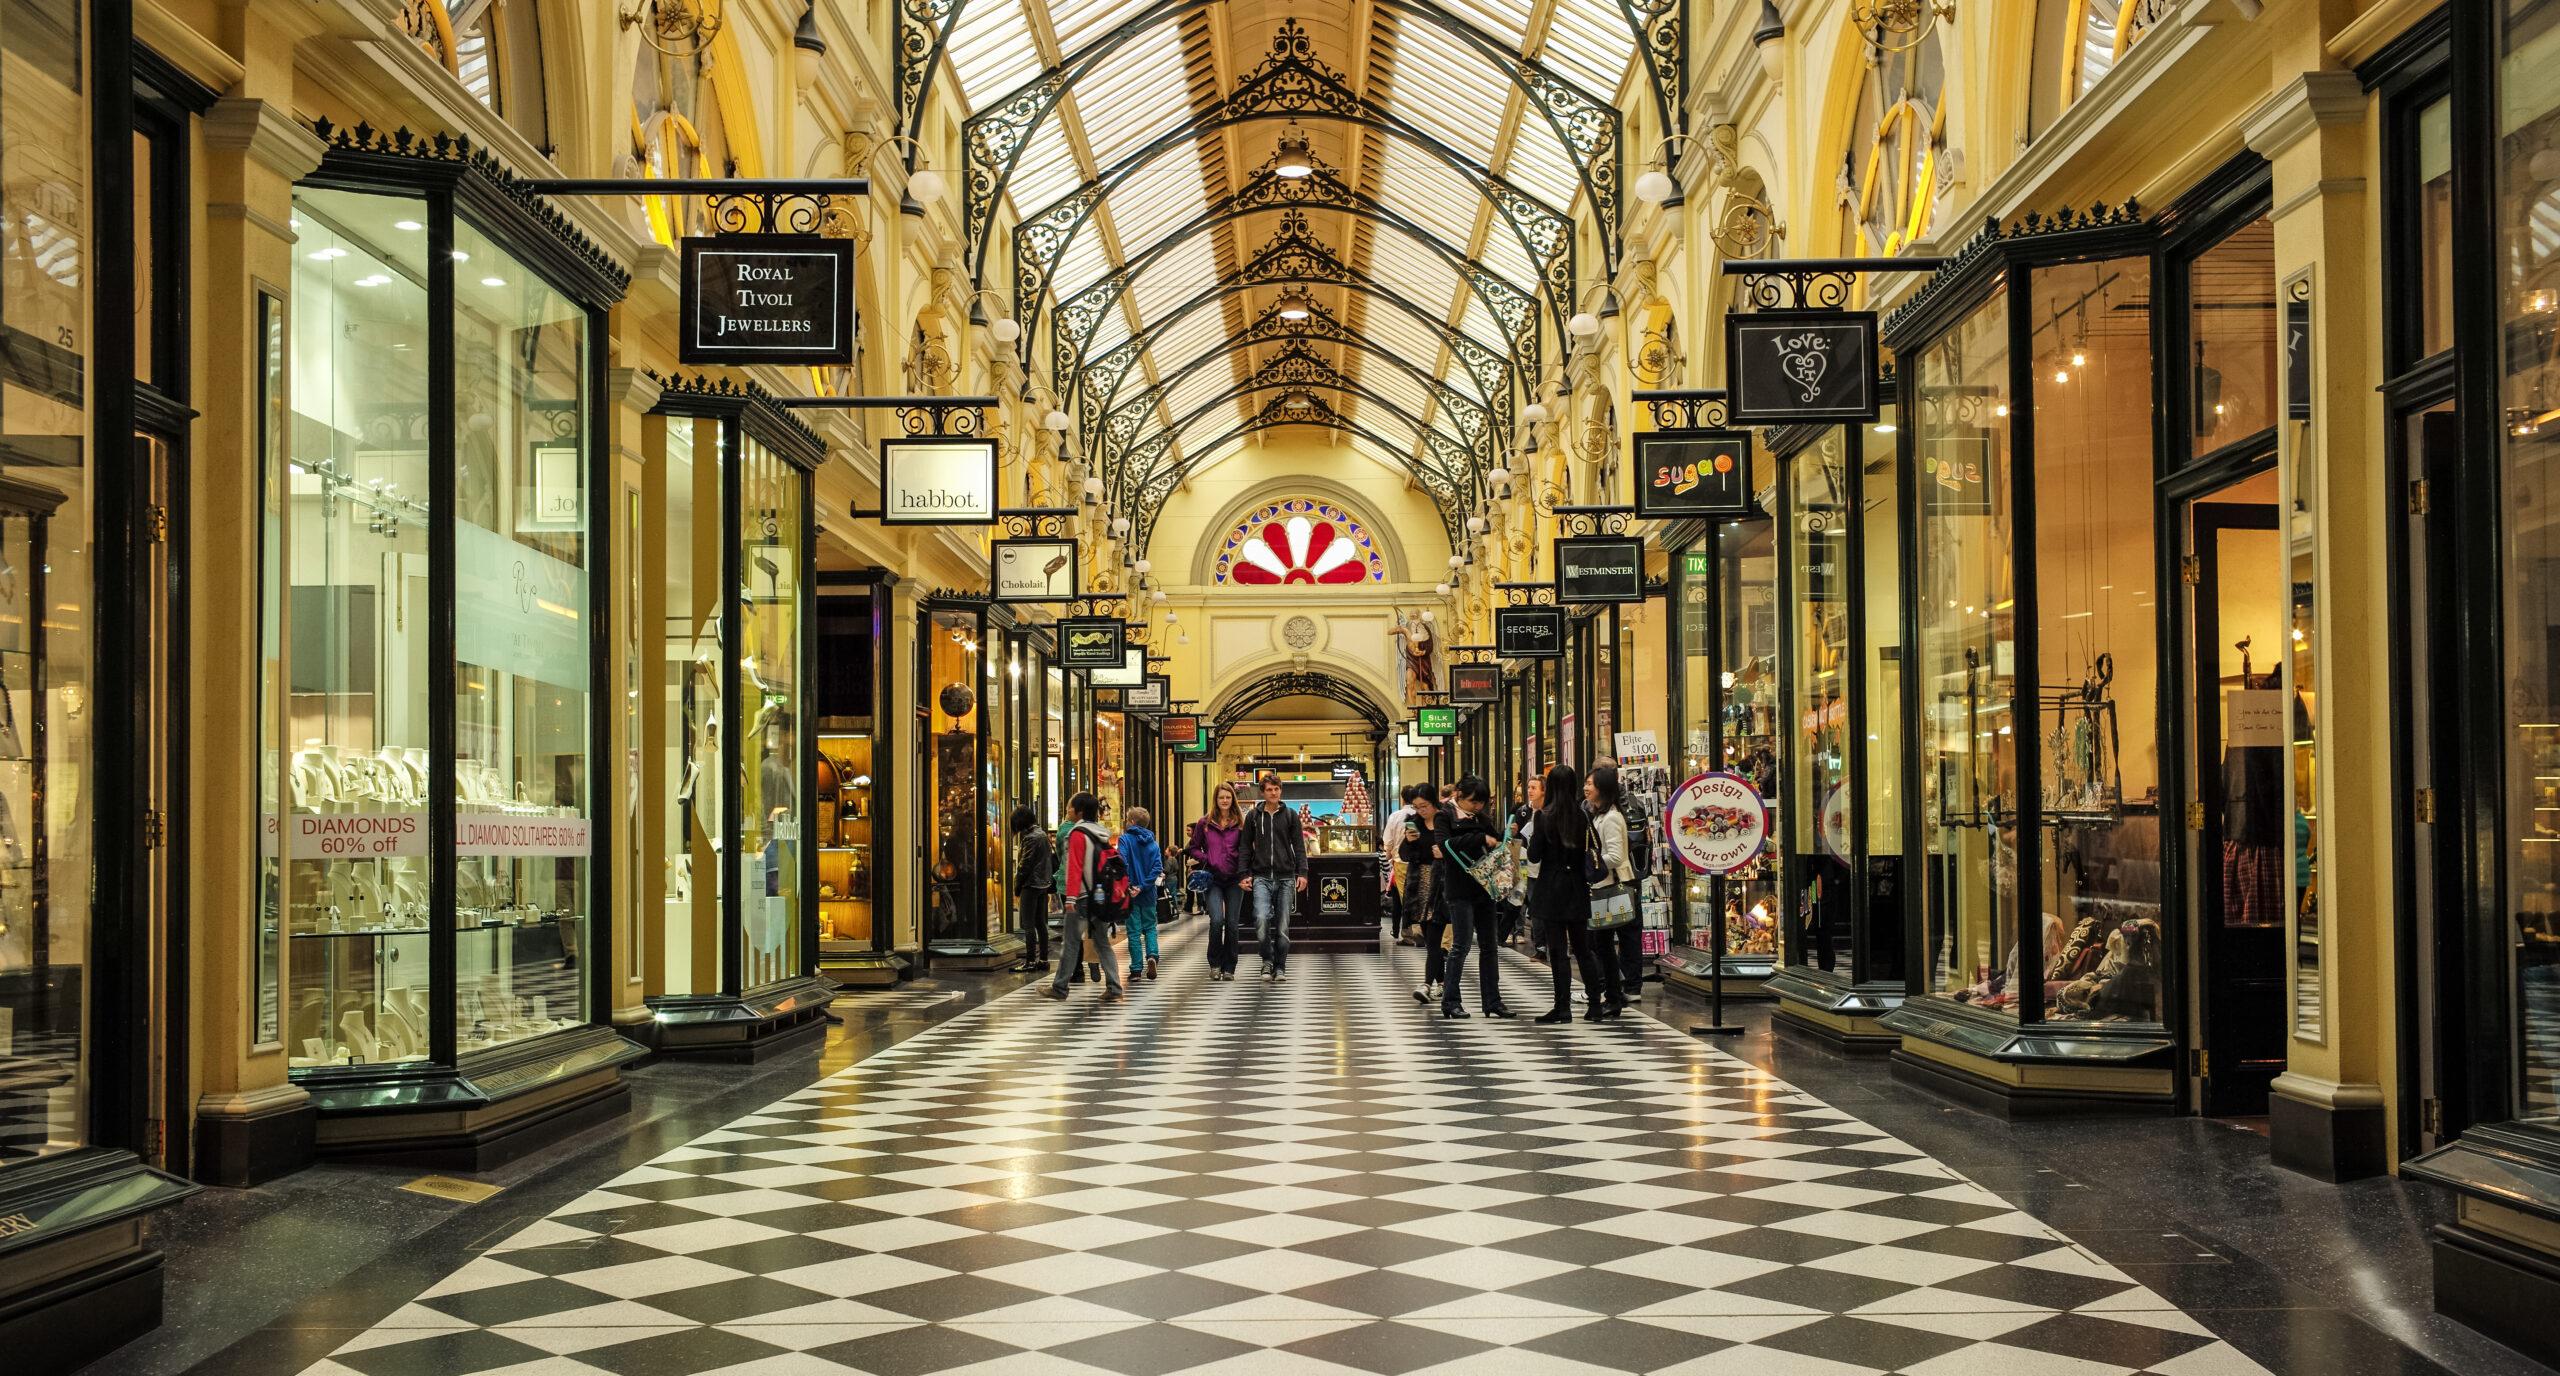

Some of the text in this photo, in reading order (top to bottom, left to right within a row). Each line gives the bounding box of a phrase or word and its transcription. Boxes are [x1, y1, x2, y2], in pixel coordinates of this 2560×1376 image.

[736, 263, 794, 281] ROYAL
[736, 289, 793, 307] TIVOLI
[717, 315, 811, 336] JEWELLERS
[57, 326, 74, 349] 25
[1796, 366, 1816, 381] IT
[900, 489, 979, 508] habbot.
[1565, 564, 1634, 579] WESTMINSTER
[1001, 579, 1046, 589] Chokolait.
[1506, 625, 1549, 634] SECRETS
[1424, 721, 1453, 729] STORE
[1690, 780, 1743, 801] Design
[302, 817, 416, 835] DIAMONDS
[468, 824, 511, 846] DIAMOND
[512, 825, 558, 847] SOLITAIRES
[559, 827, 575, 847] 60%
[576, 828, 586, 847] off
[321, 836, 398, 854] 60% off
[1683, 842, 1748, 862] your own
